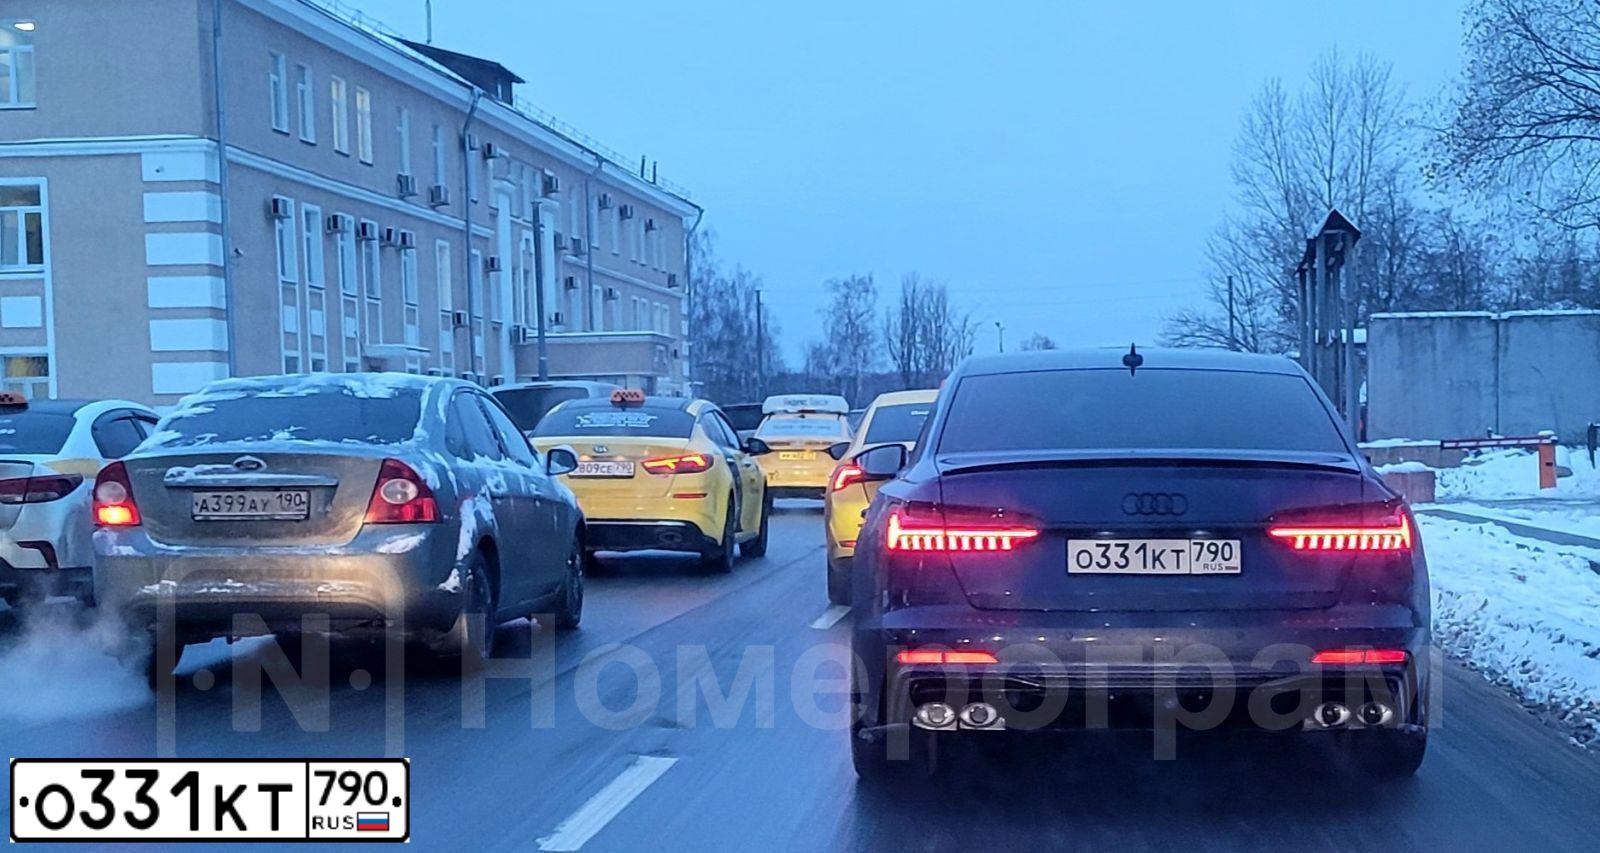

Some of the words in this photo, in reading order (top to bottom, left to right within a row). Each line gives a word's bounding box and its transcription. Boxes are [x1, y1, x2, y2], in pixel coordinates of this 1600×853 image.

[574, 463, 613, 474] 809СЕ
[199, 494, 271, 513] А399АУ
[276, 492, 303, 507] 190
[1076, 542, 1186, 570] О331КТ
[1192, 541, 1234, 562] 790
[1202, 563, 1224, 571] RUS
